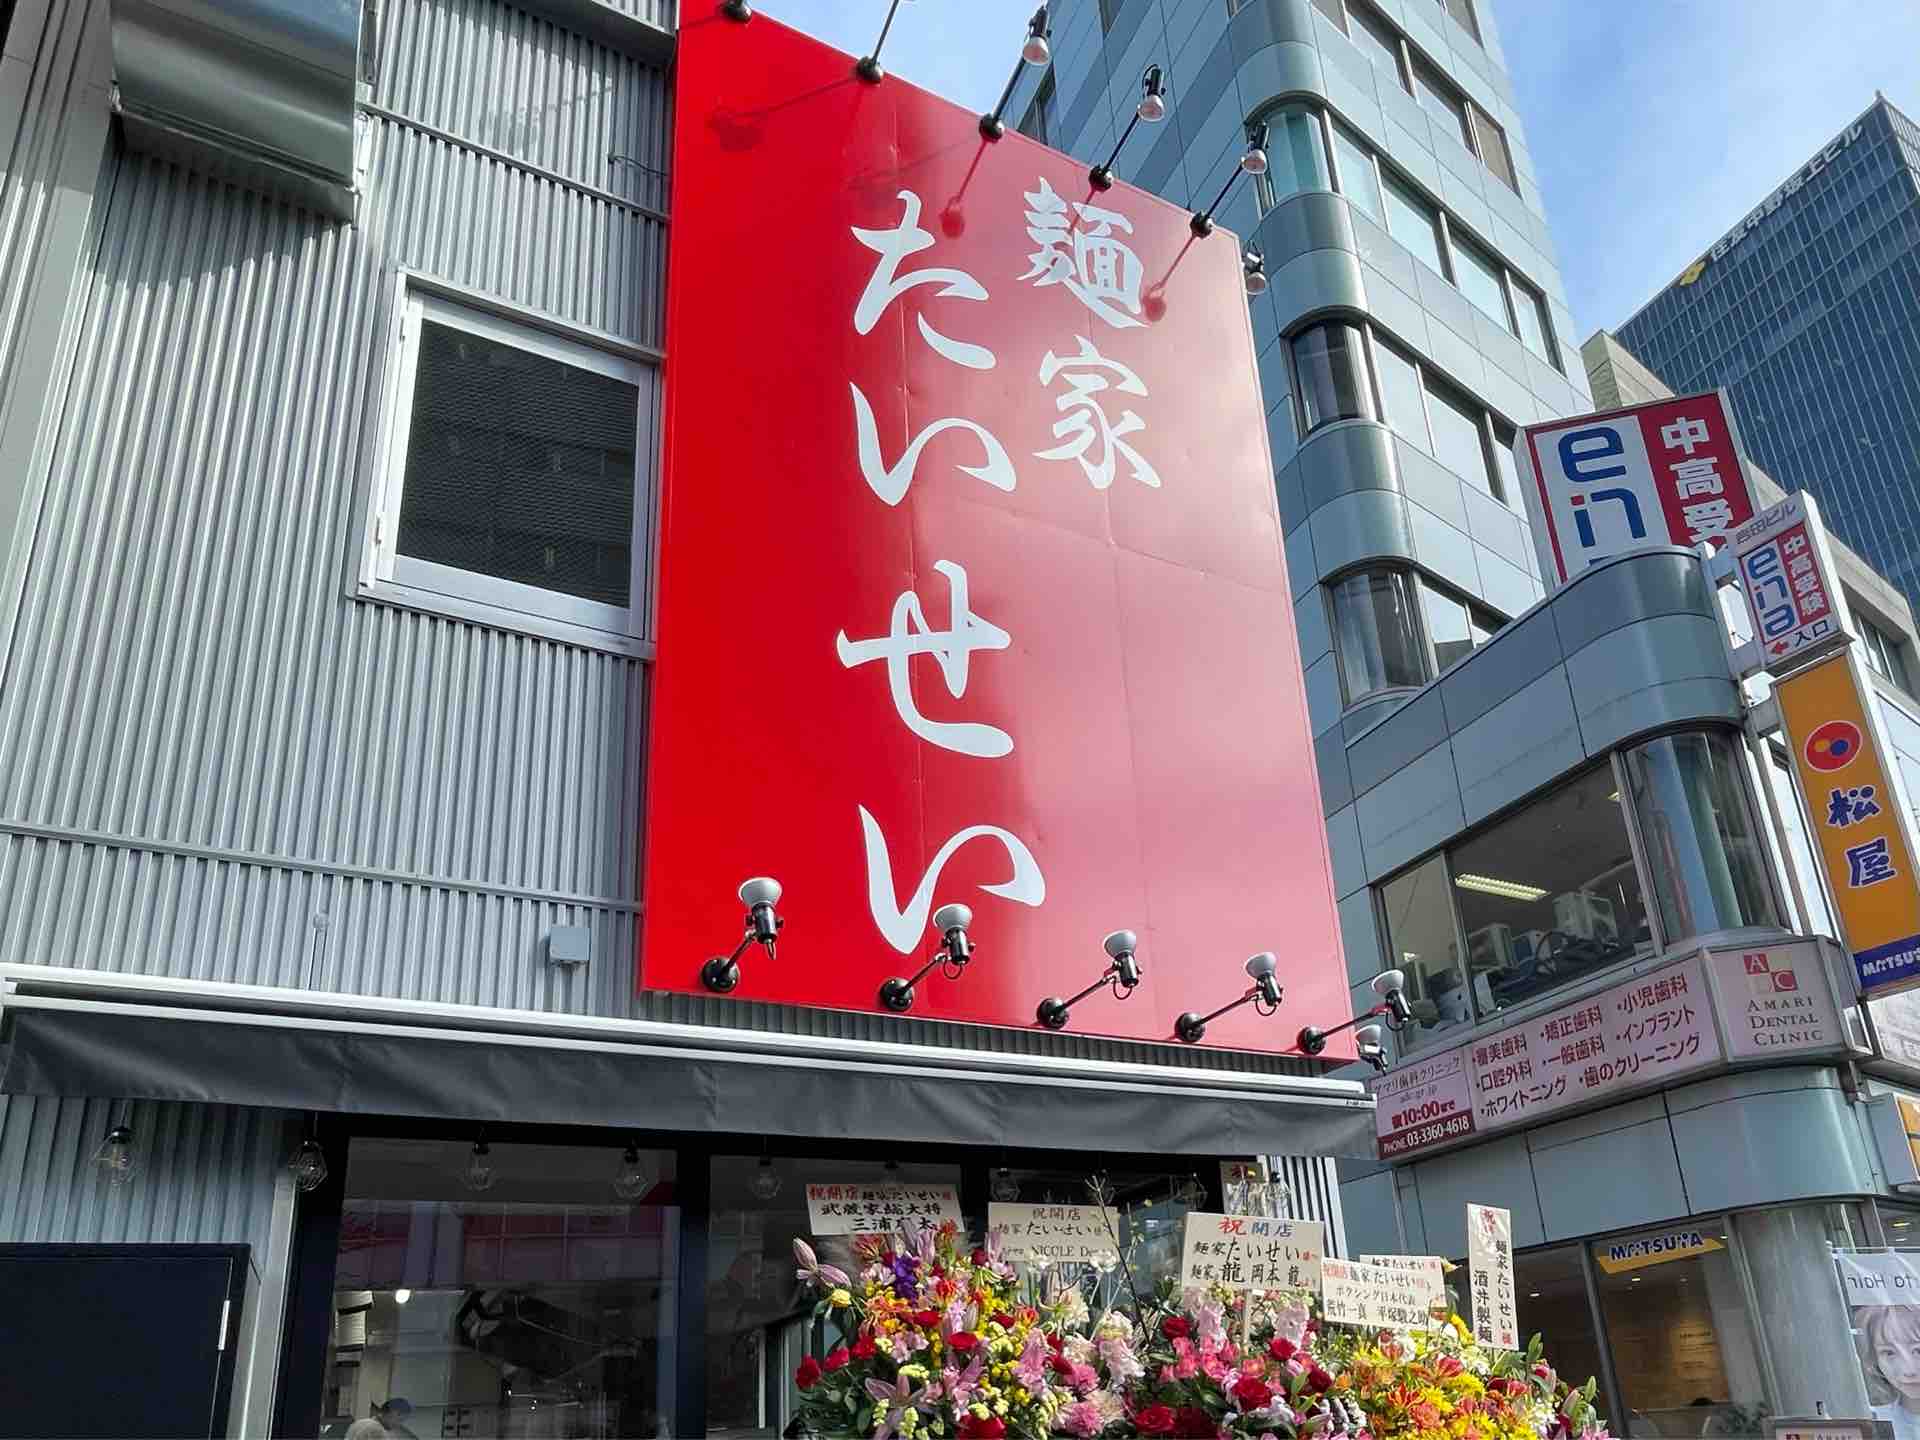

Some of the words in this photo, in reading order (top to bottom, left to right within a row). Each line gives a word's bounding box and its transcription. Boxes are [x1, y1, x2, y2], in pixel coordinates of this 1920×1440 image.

[1016, 176, 1163, 491] 麺家
[836, 190, 1047, 955] たいせい
[1794, 619, 1830, 648] 入口
[1825, 784, 1896, 888] 松屋
[1751, 1013, 1819, 1030] DENTAL
[1753, 1030, 1824, 1047] CLINIC
